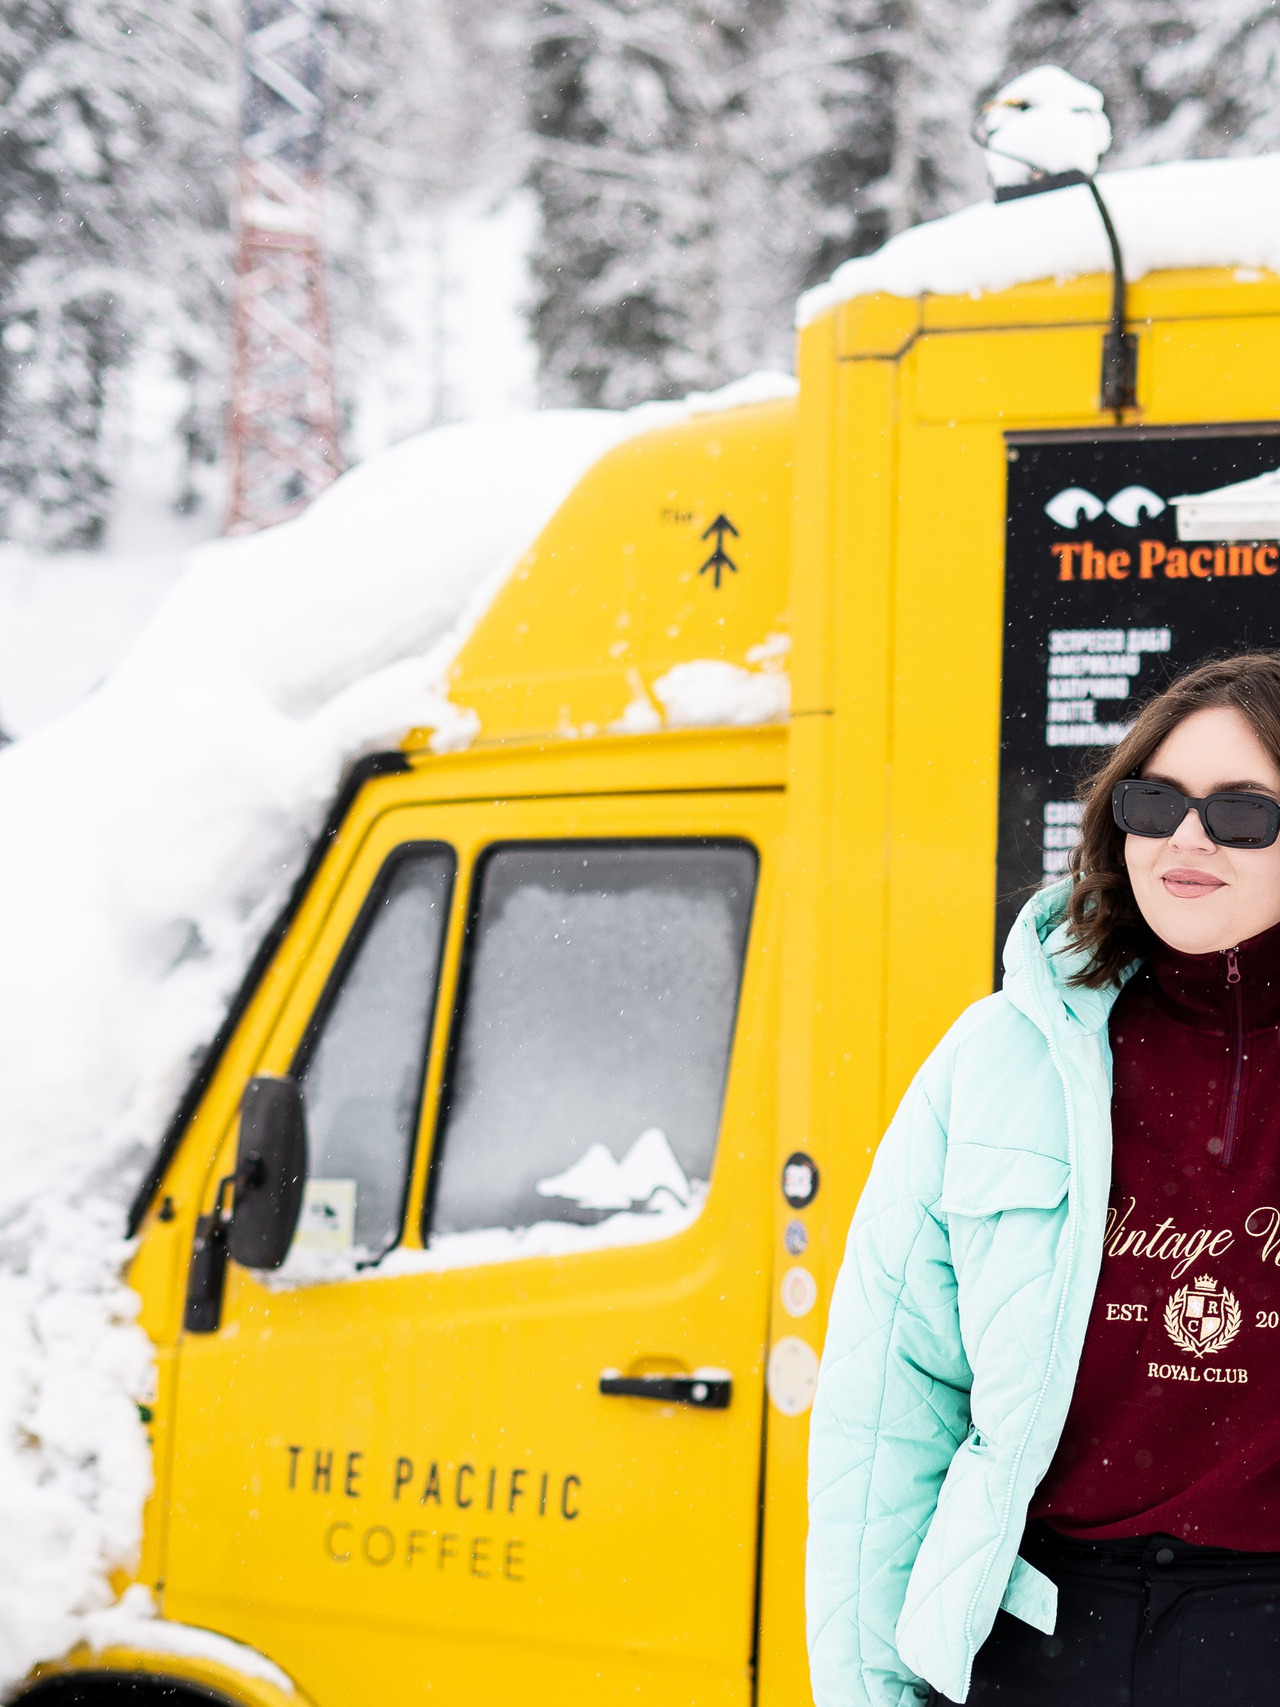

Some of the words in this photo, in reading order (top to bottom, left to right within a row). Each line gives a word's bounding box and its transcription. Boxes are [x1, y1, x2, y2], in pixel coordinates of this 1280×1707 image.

[1052, 541, 1130, 581] The
[1102, 1196, 1235, 1280] Vintage
[1106, 1304, 1149, 1322] EST.
[1207, 1301, 1219, 1315] R
[1188, 1320, 1200, 1333] C
[1148, 1363, 1201, 1382] ROYAL
[1203, 1367, 1248, 1384] CLUB
[287, 1446, 363, 1498] THE
[392, 1456, 581, 1520] PACIFIC
[324, 1521, 527, 1582] COFFEE
